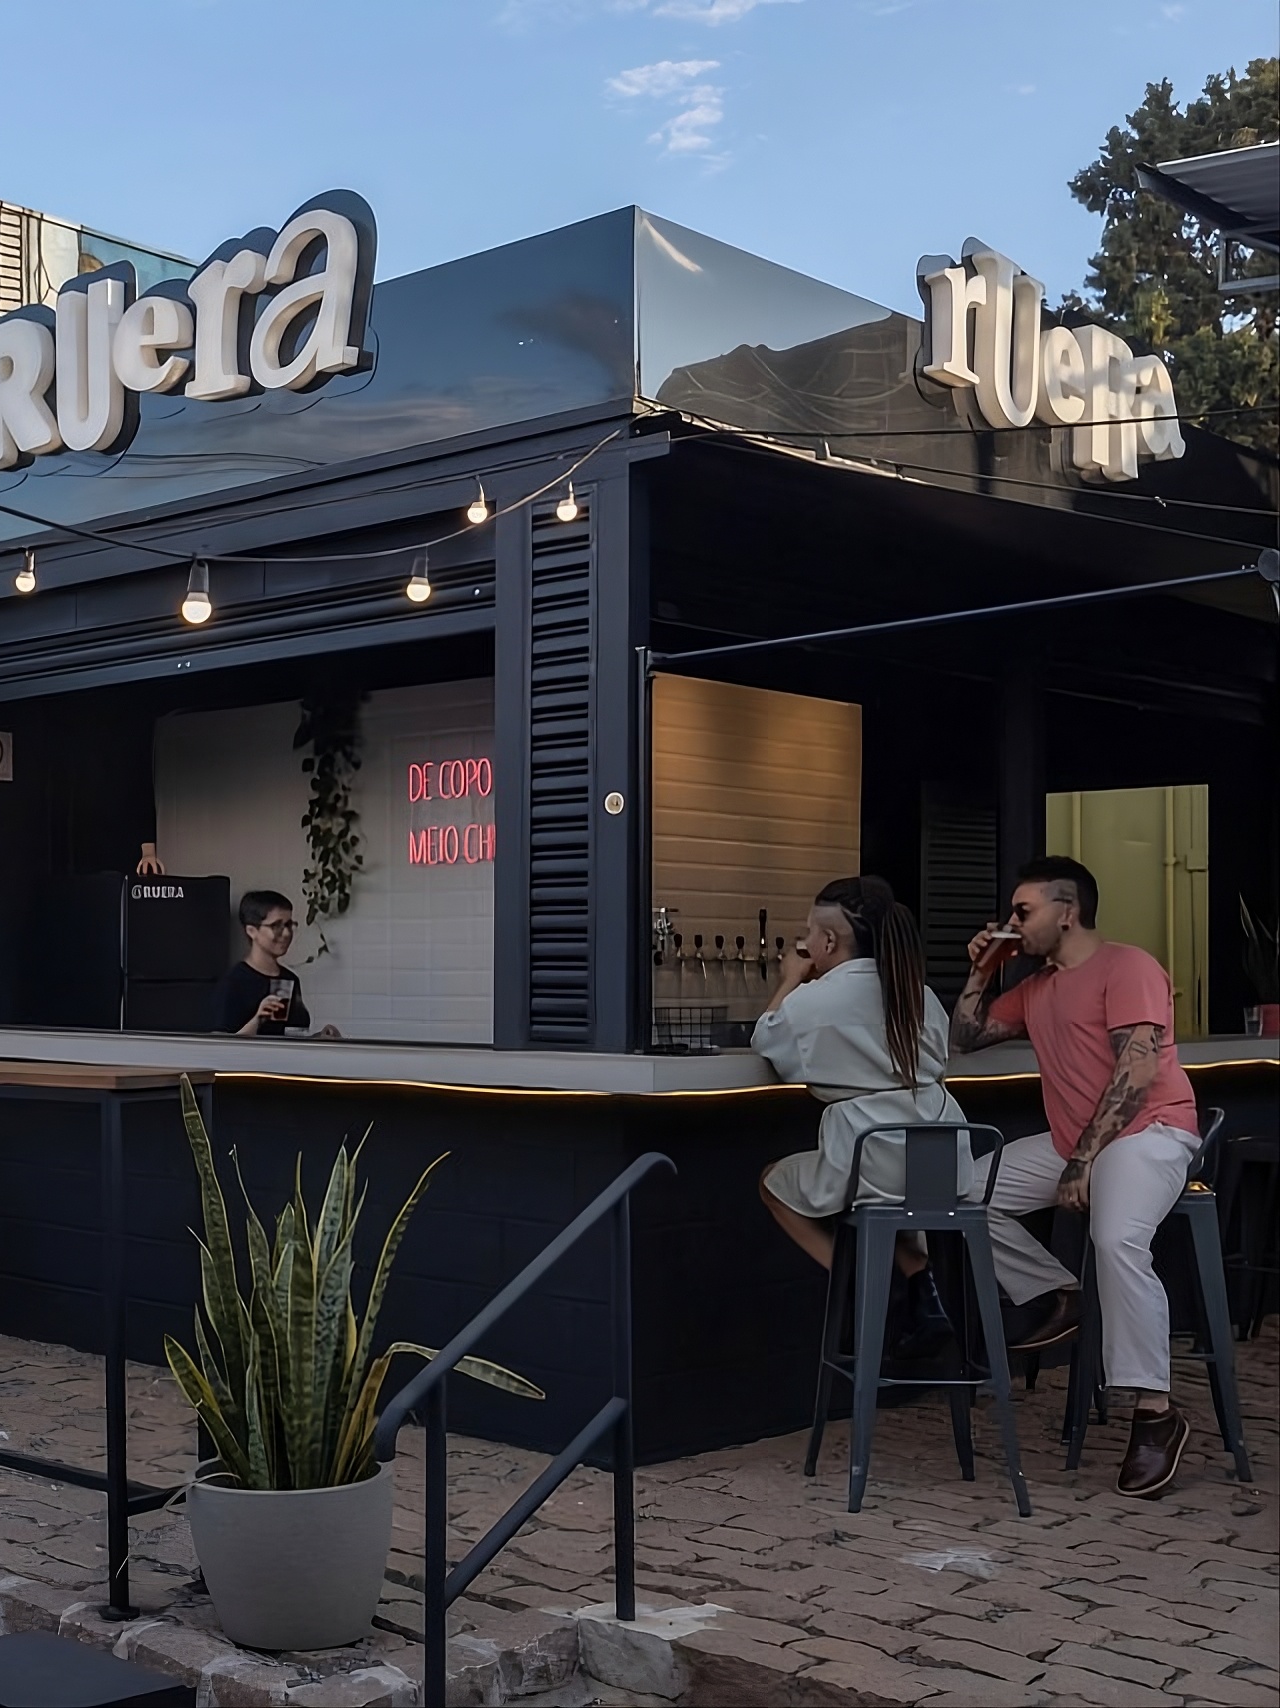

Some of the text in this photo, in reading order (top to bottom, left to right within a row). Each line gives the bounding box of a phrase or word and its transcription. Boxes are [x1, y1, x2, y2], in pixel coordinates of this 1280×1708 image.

[409, 758, 492, 802] DE COPO
[409, 826, 459, 864] MEIO
